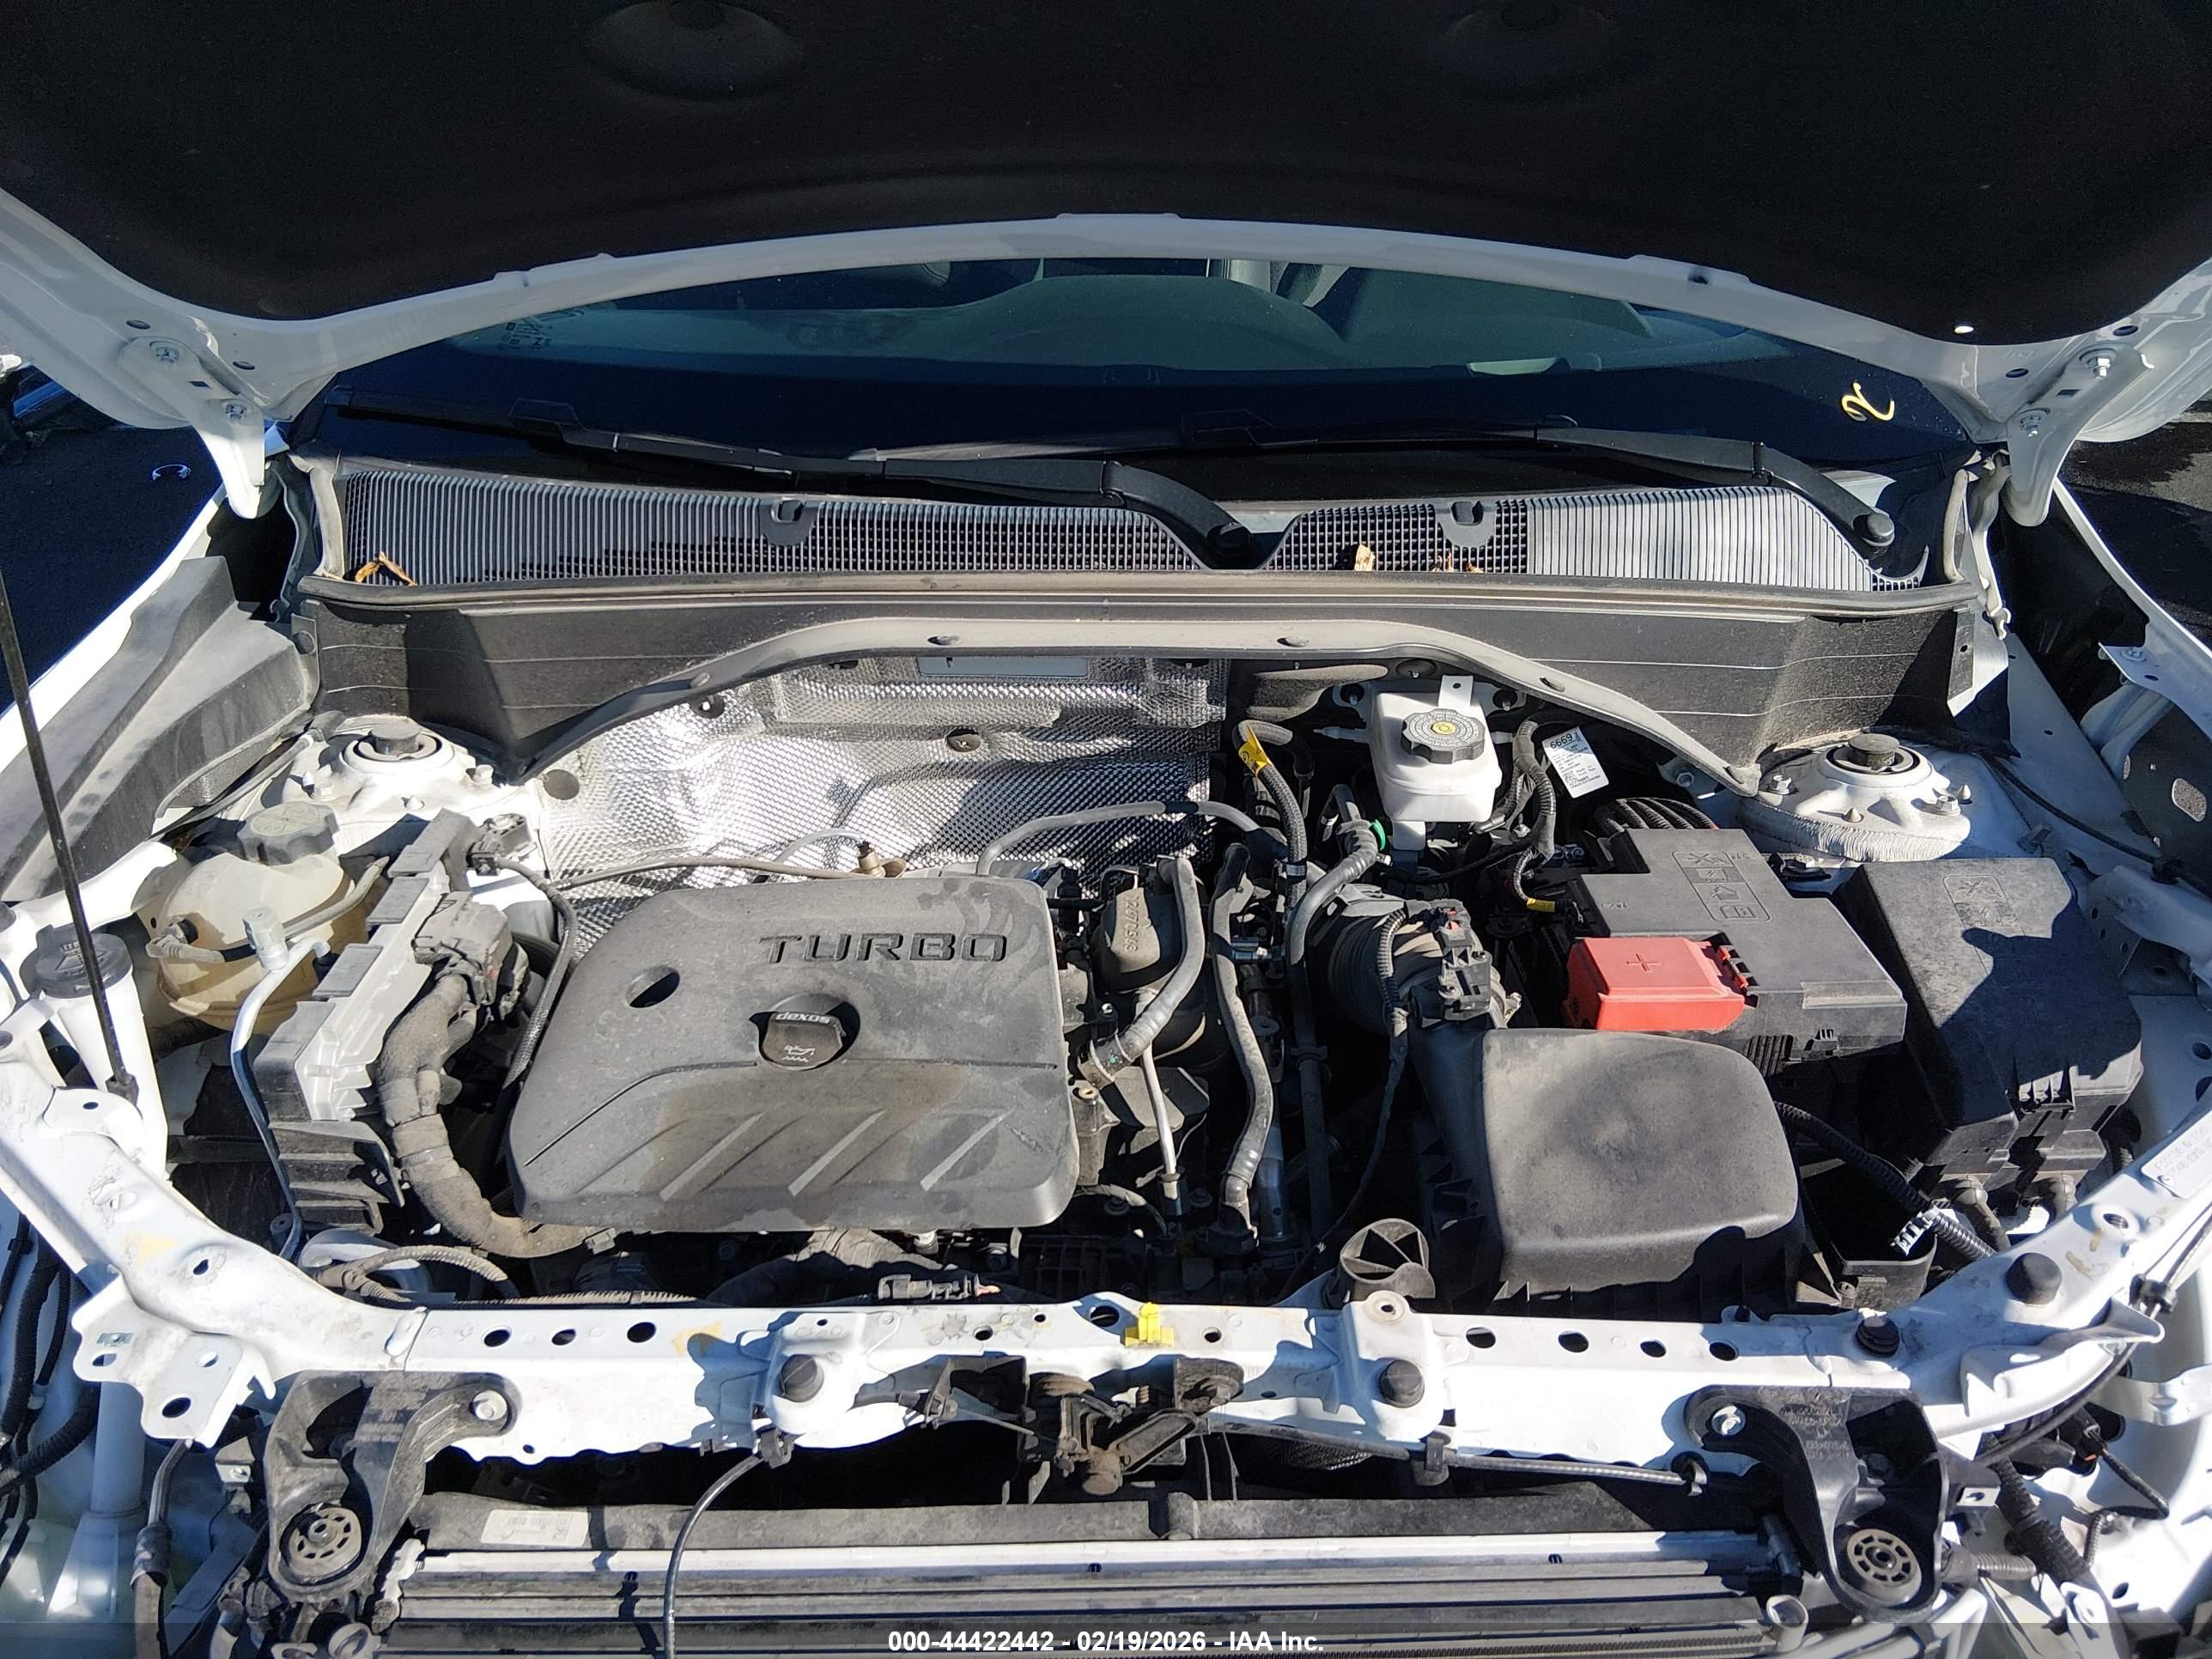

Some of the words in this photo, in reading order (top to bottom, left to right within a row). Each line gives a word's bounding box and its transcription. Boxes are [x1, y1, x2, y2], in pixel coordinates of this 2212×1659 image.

[1550, 732, 1574, 750] 6669
[757, 933, 1009, 964] TURBO
[775, 1012, 831, 1024] dexos
